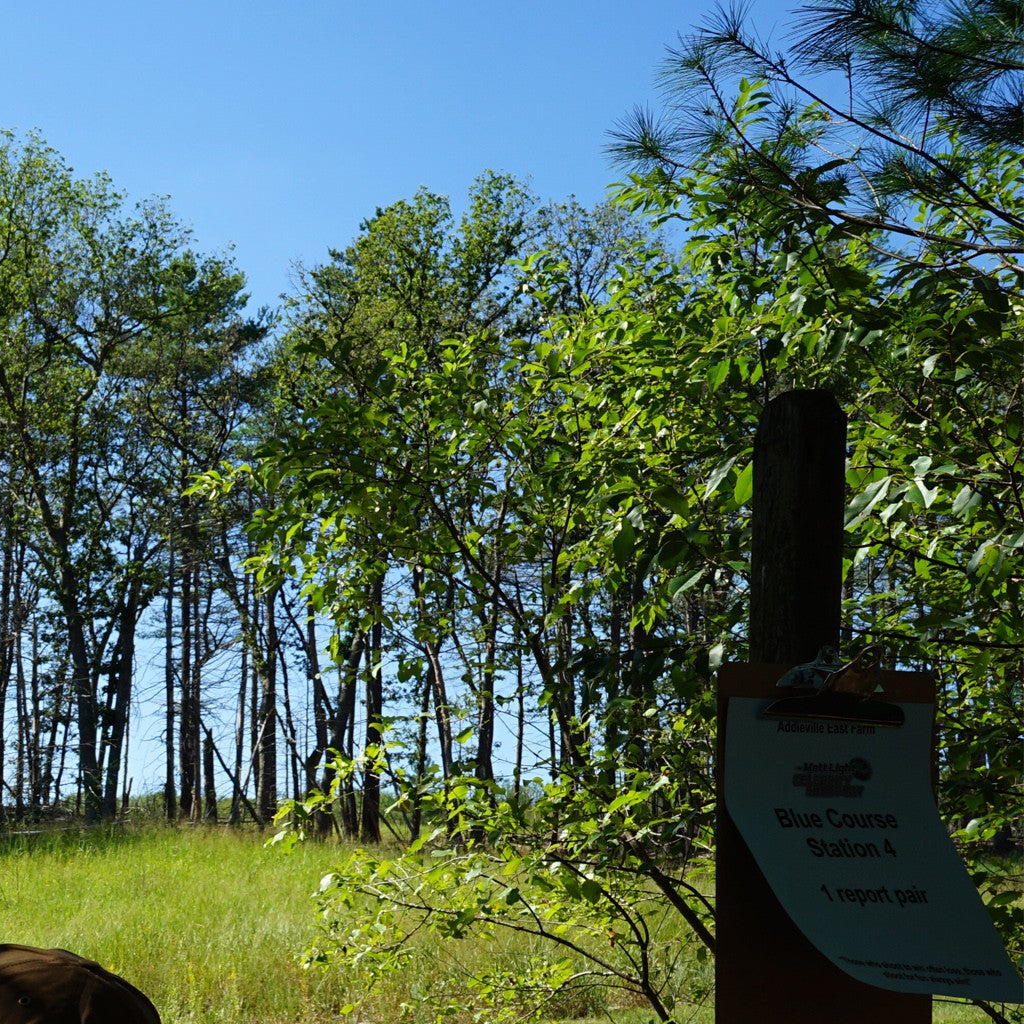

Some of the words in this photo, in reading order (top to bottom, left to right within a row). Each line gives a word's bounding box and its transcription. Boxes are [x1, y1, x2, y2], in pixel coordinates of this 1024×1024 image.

[777, 721, 824, 734] Addieville
[827, 722, 849, 735] East
[774, 808, 824, 829] Blue
[825, 808, 899, 829] Course
[806, 837, 881, 858] Station
[883, 838, 897, 859] 4
[820, 884, 834, 902] 1
[836, 886, 893, 907] report
[894, 885, 929, 908] pair
